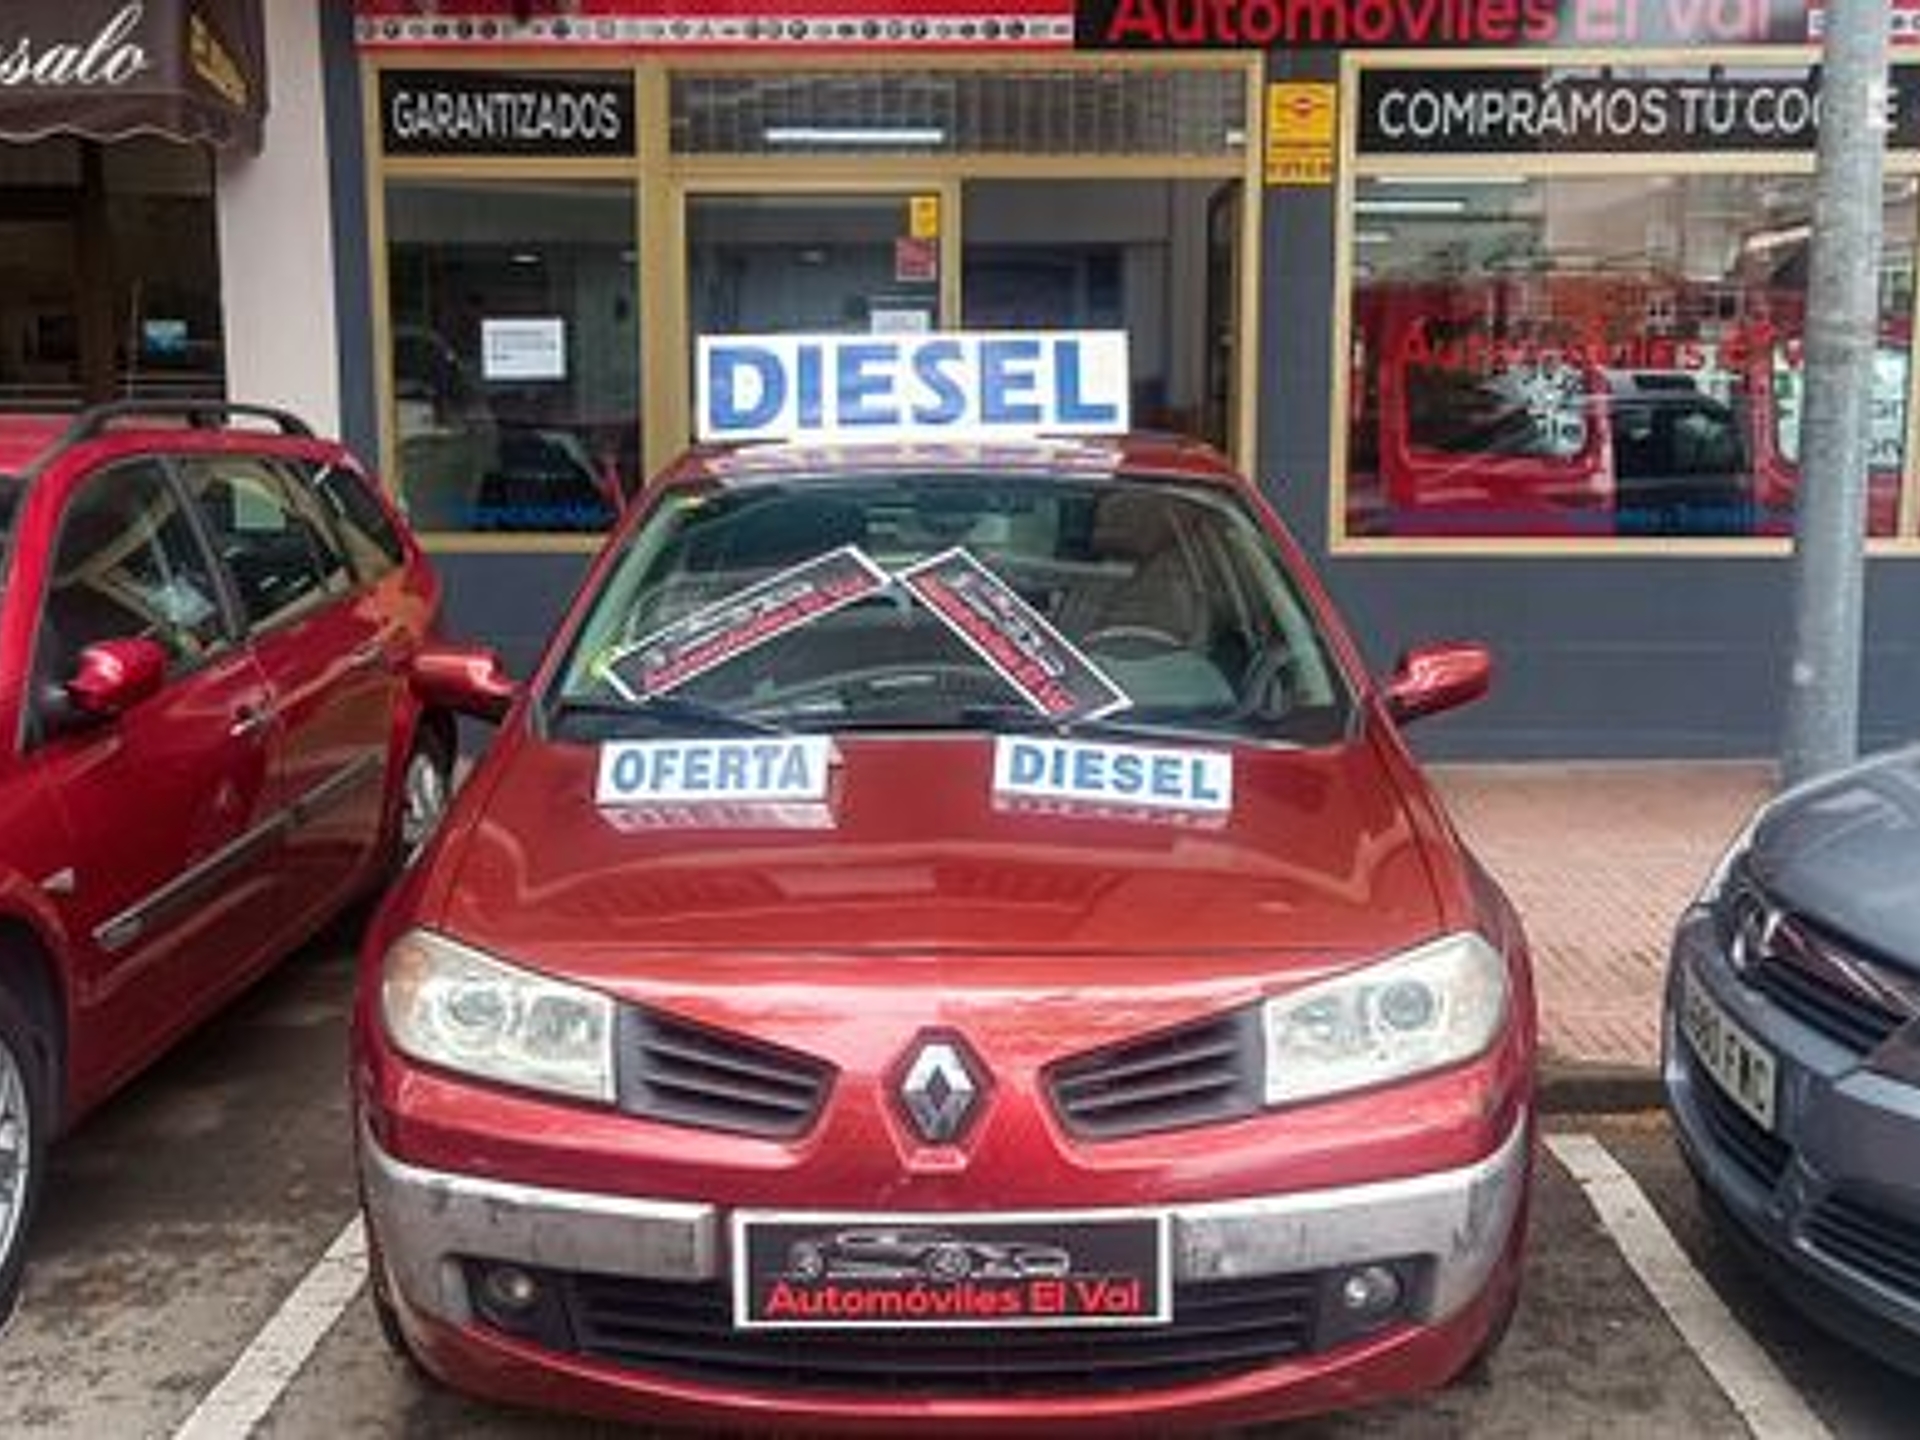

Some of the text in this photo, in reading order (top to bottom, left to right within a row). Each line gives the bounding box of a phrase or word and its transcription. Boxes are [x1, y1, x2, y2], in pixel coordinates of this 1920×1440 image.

[391, 92, 621, 140] GARANTIZADOS
[1680, 88, 1736, 134] TU
[708, 338, 1120, 431] DIESEL
[612, 743, 811, 794] OFERTA
[1009, 743, 1219, 801] DIESEL
[765, 1279, 1020, 1315] Automóviles
[1030, 1280, 1065, 1313] El
